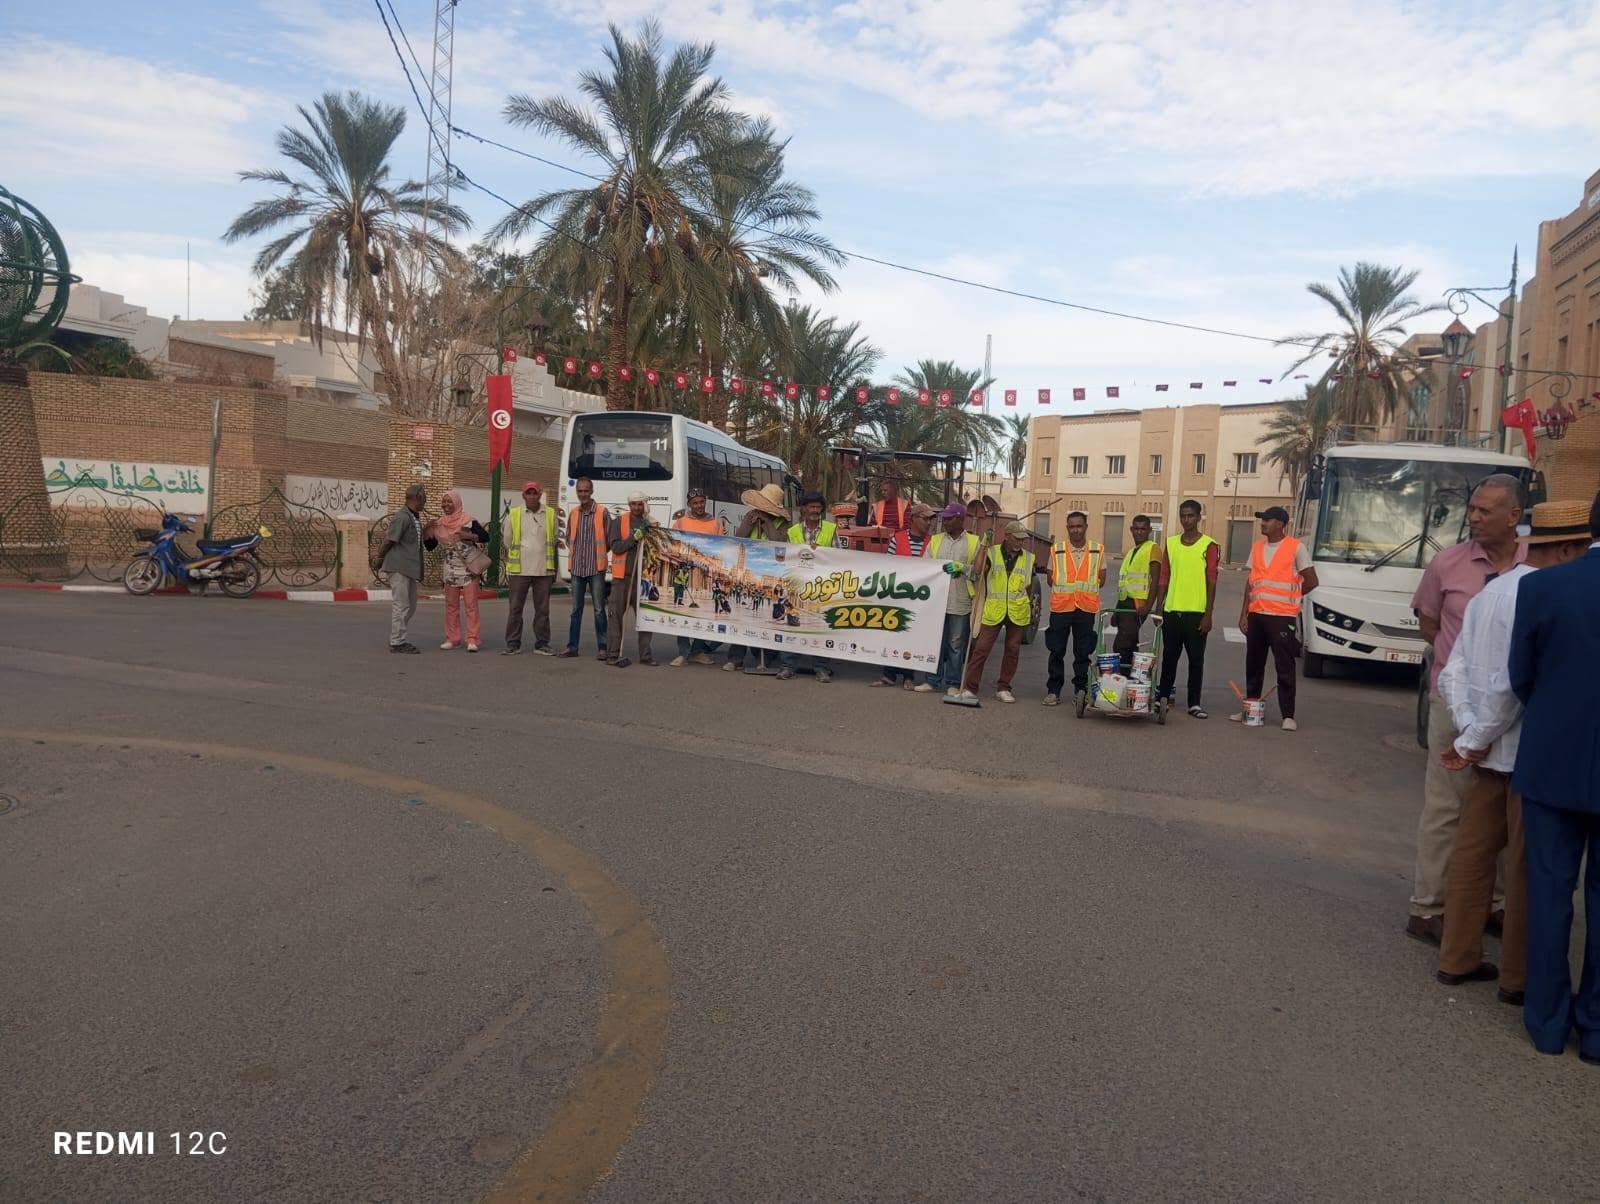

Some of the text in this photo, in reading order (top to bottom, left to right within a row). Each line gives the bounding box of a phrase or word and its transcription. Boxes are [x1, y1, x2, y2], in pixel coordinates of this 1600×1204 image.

[653, 438, 668, 450] 11
[602, 471, 636, 479] ISUZU
[800, 570, 931, 602] محلاك يا توزر
[834, 608, 899, 630] 2026
